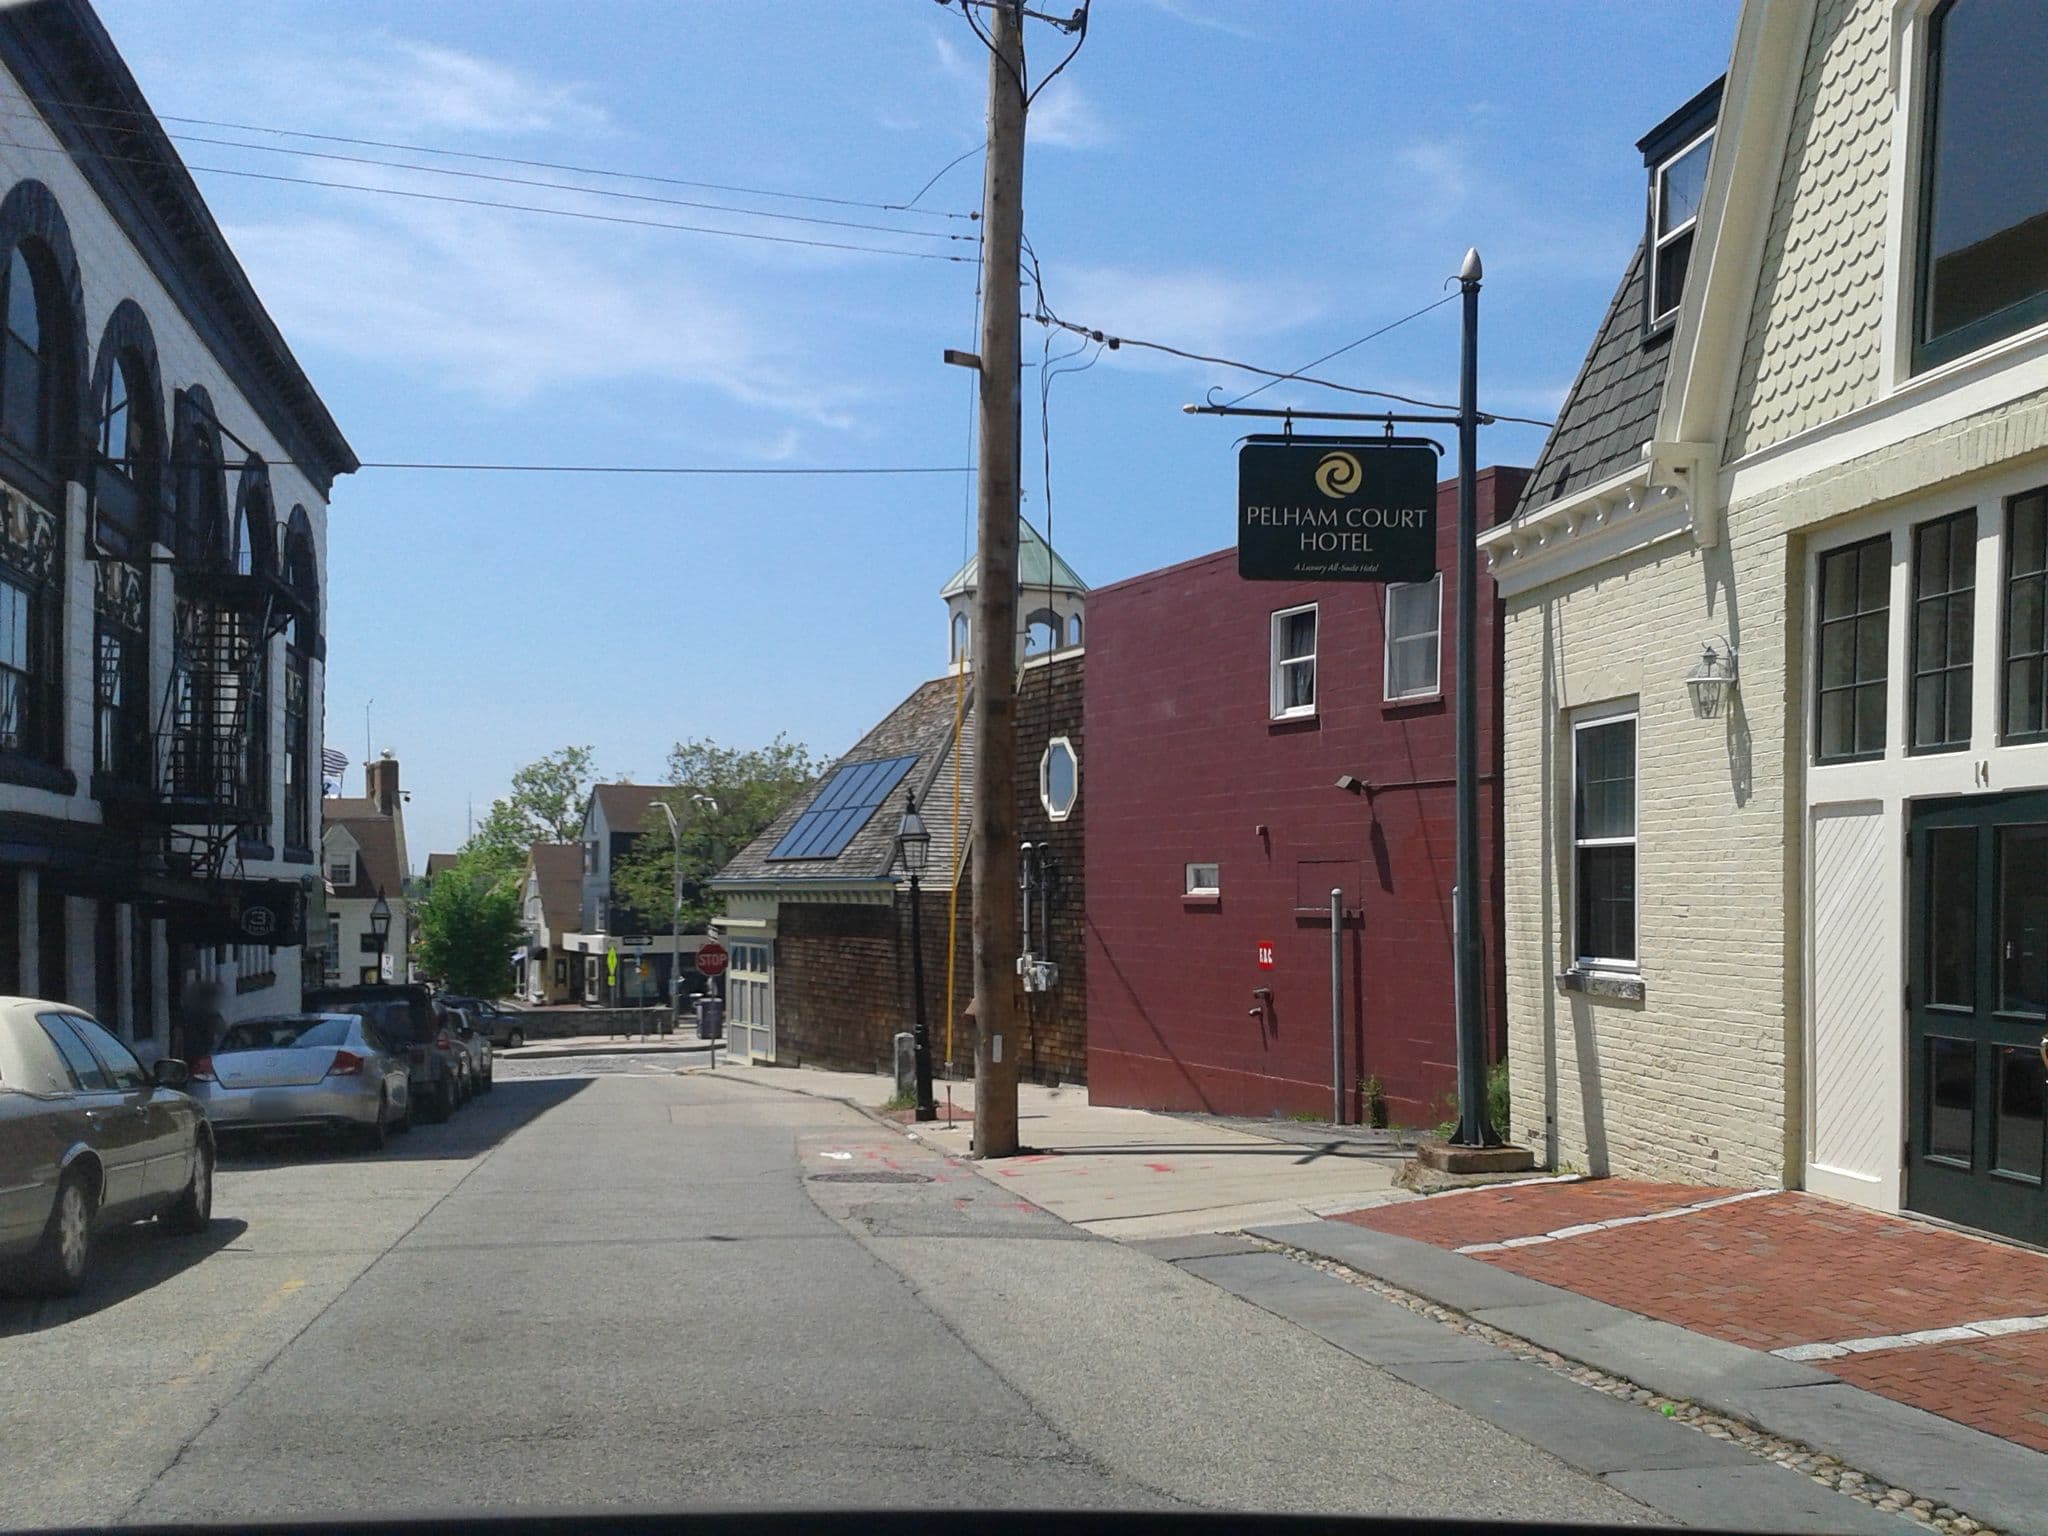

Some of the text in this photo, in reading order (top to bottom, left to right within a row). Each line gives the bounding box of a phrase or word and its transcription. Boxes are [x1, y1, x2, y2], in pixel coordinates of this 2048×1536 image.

[1247, 506, 1428, 528] PELHAM COURT
[1300, 533, 1374, 552] HOTEL
[1301, 563, 1327, 574] Luxury
[698, 953, 728, 966] STOP
